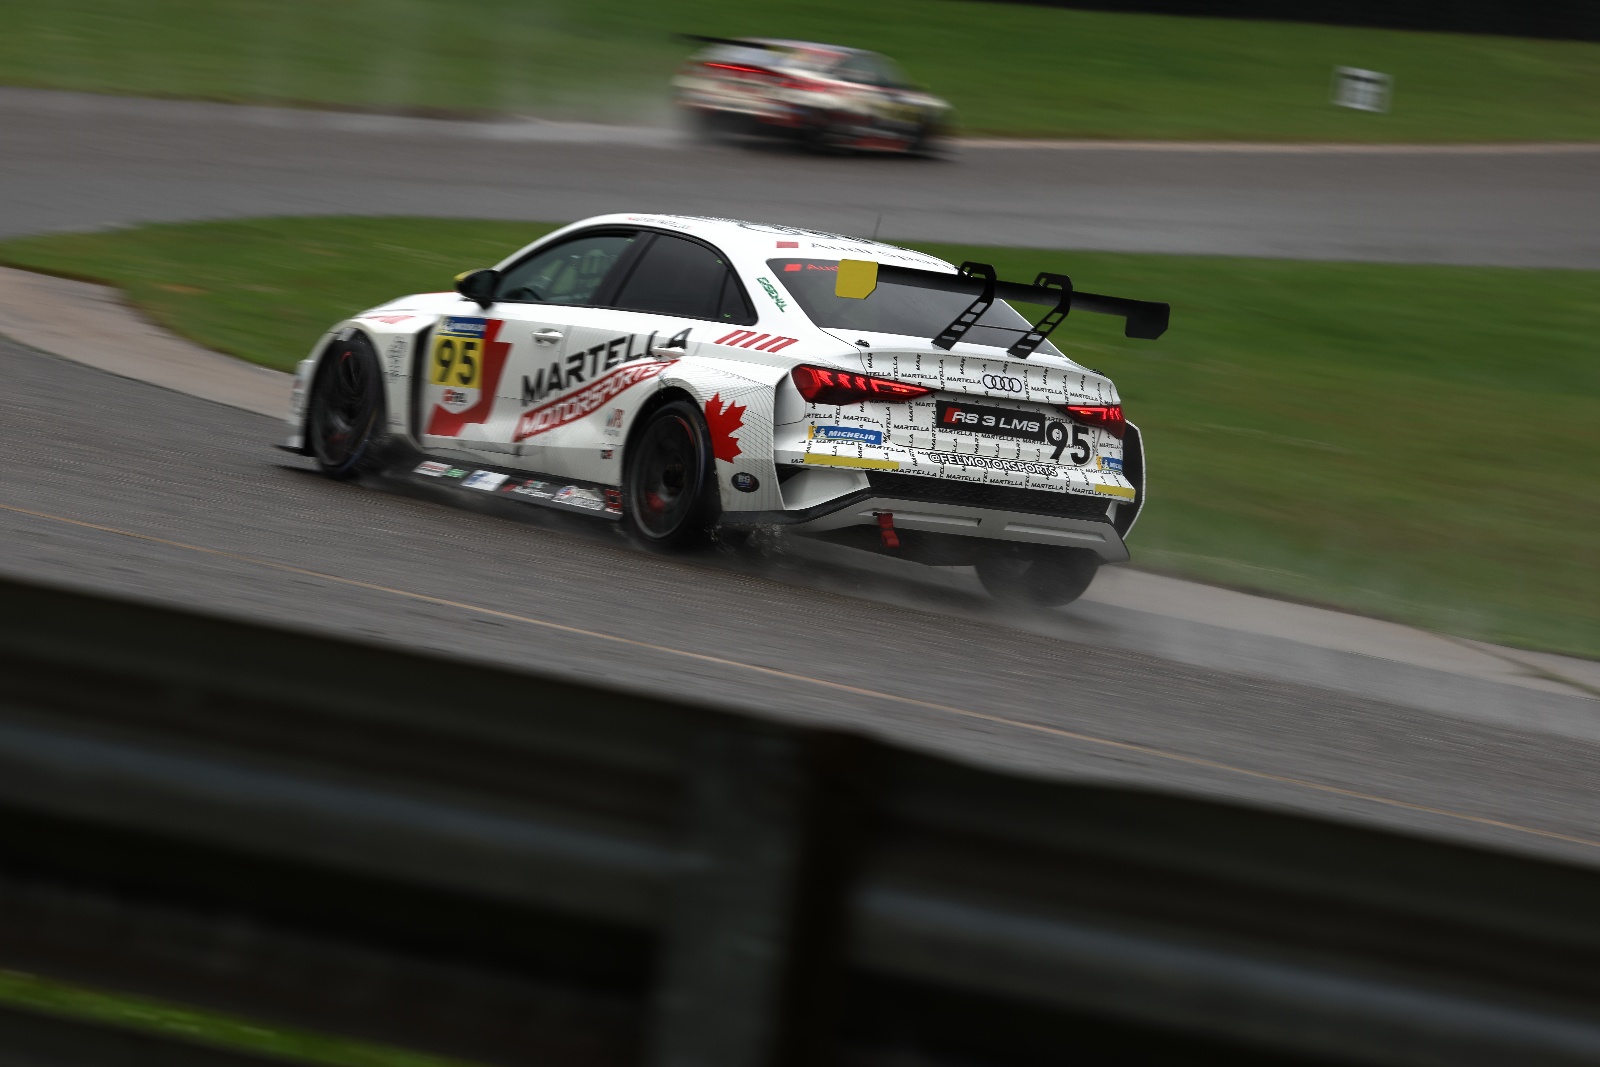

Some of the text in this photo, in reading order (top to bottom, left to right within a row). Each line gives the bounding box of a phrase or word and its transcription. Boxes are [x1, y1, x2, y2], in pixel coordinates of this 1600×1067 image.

[436, 339, 477, 385] 95
[901, 372, 938, 380] MARTELLA
[946, 376, 981, 385] MARTELLA
[1031, 386, 1063, 395] MARTELLA
[521, 361, 673, 434] MOTORSPORTS
[1069, 391, 1099, 402] MARTELLA
[842, 414, 880, 424] MARTELLA
[951, 411, 1040, 432] RS 3 LMS
[893, 423, 930, 432] MARTELLA
[828, 430, 876, 441] MICHELIN
[938, 428, 973, 437] MARTELLA
[981, 433, 1015, 442] MARTELLA
[1046, 421, 1090, 465] 95
[928, 452, 1058, 477] @FELMOTORSPORTS
[945, 474, 980, 482] MARTELLA
[989, 478, 1023, 487] MARTELLA
[1031, 482, 1064, 491] MARTELLA
